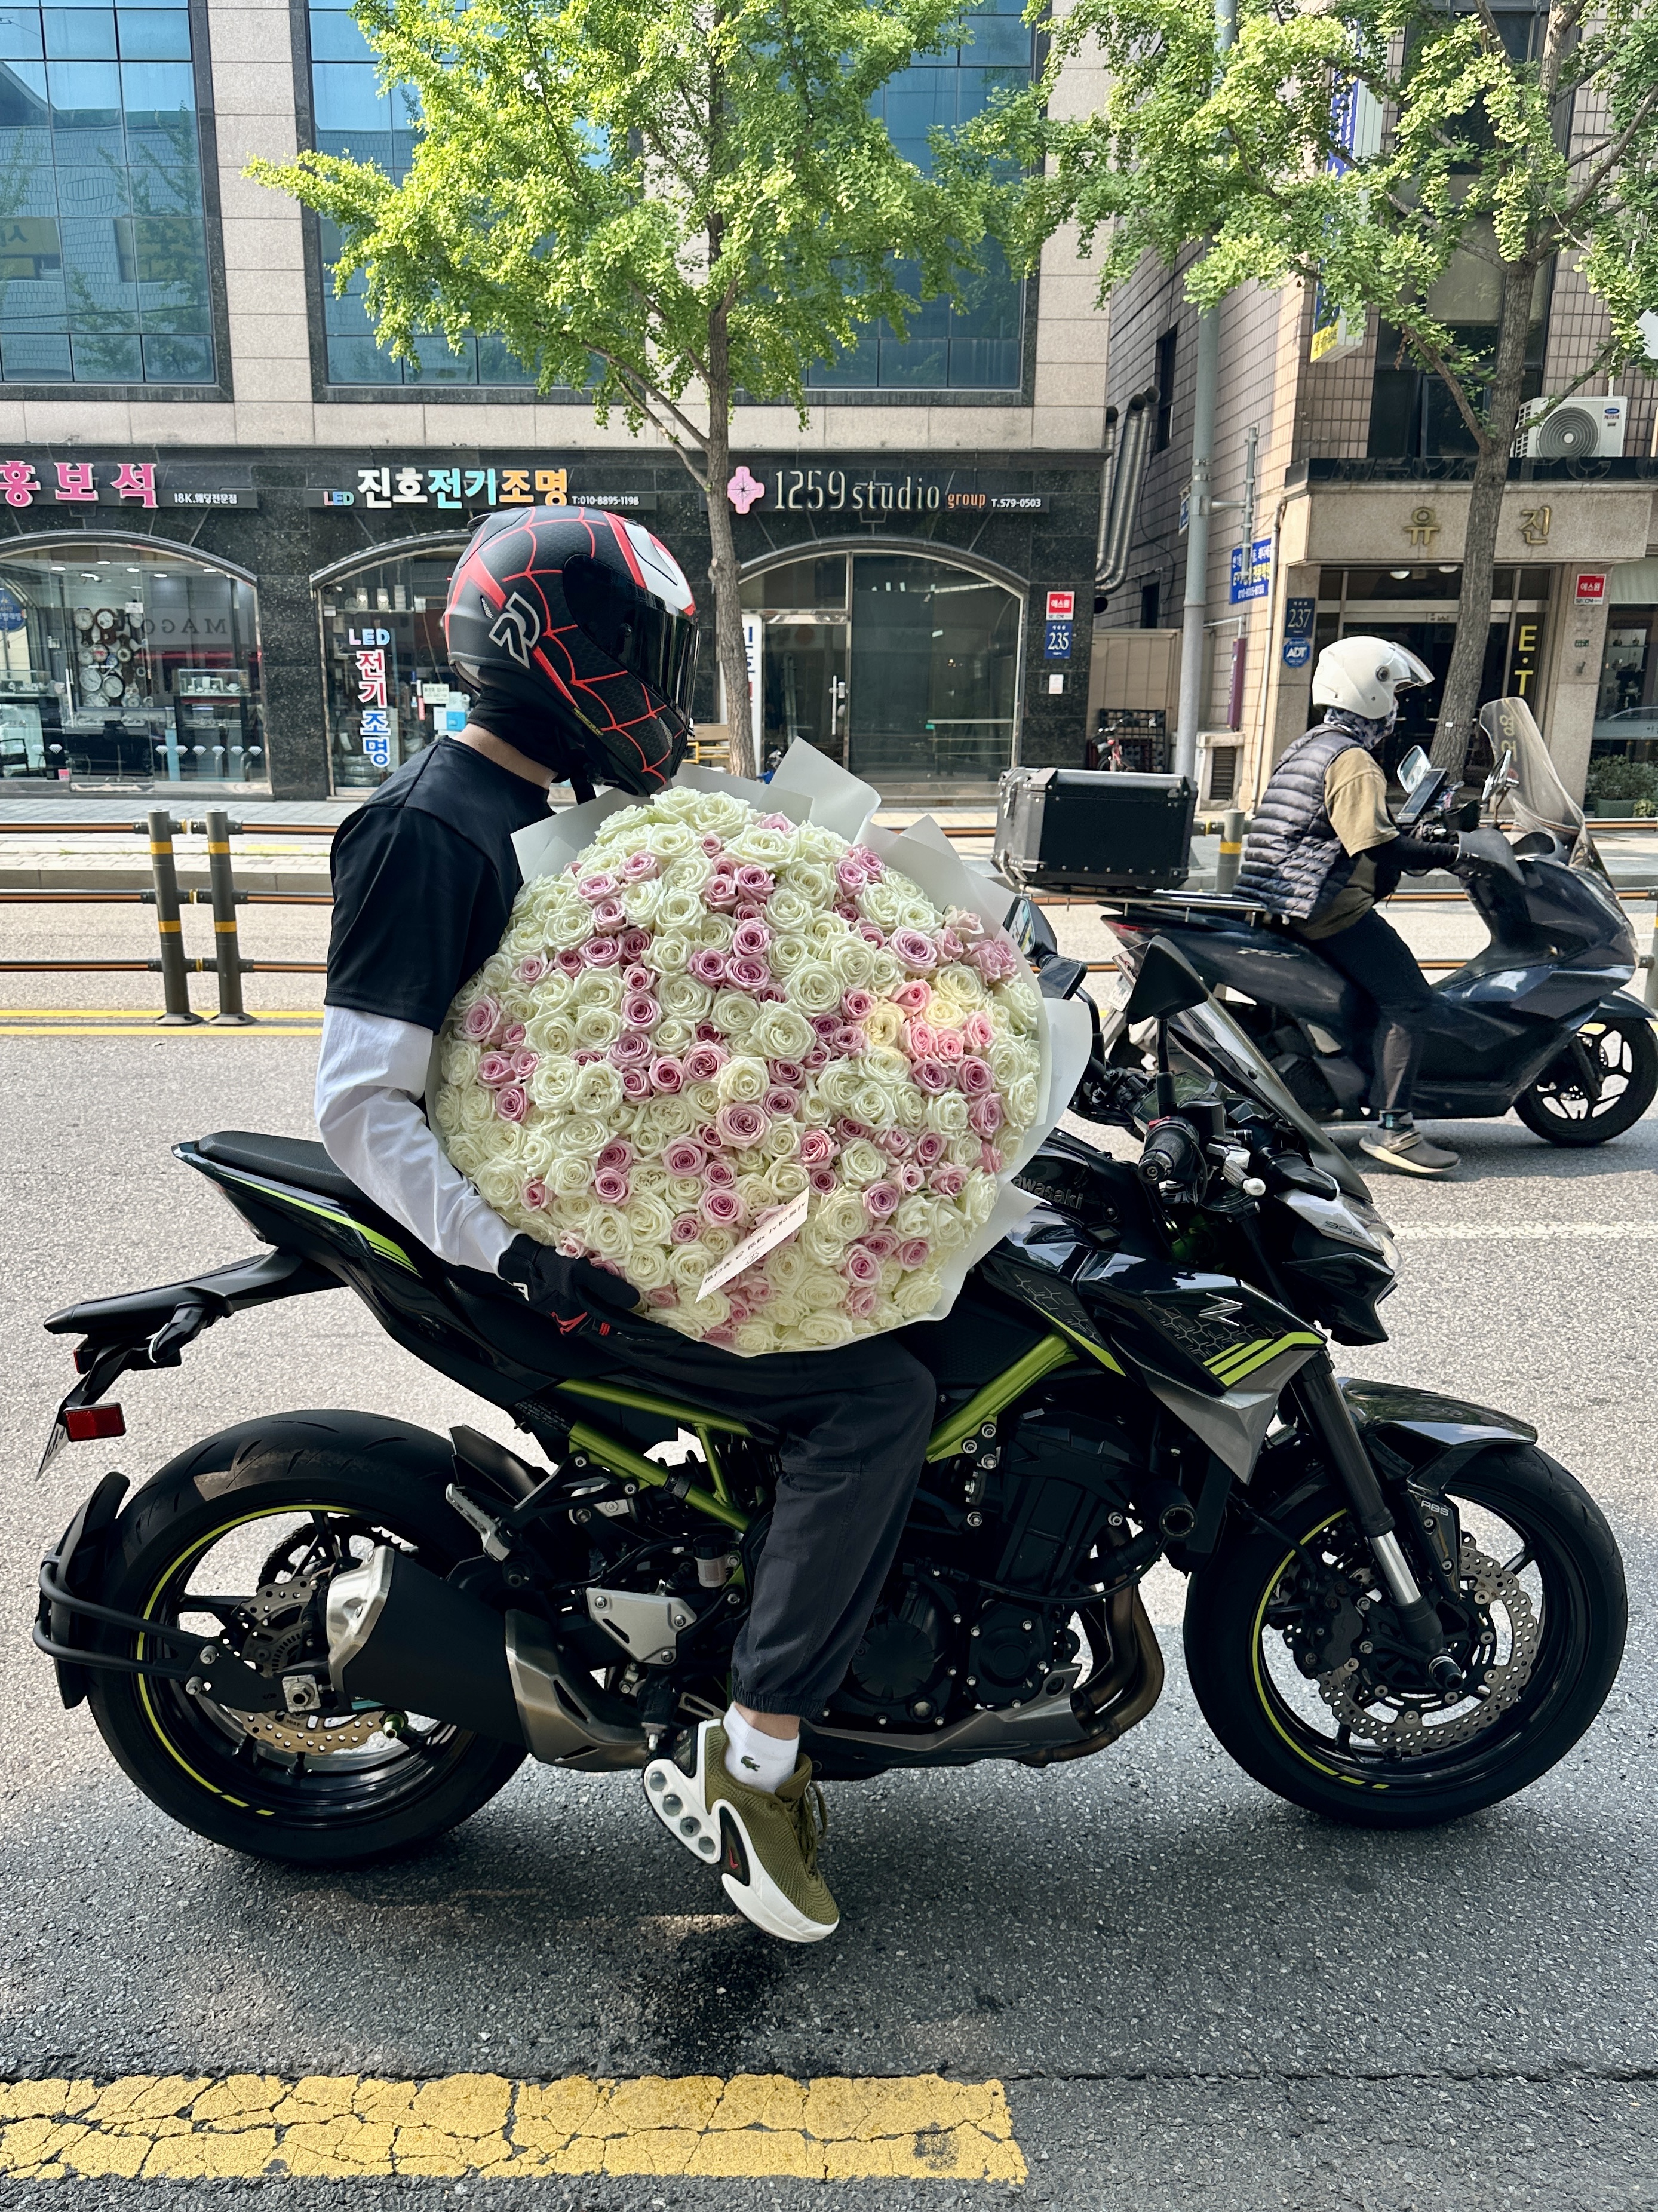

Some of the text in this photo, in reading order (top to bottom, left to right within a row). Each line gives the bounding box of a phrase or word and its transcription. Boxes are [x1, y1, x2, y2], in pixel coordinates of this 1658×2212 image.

[323, 490, 355, 506] LED
[357, 467, 568, 509] 진호전기조명
[774, 470, 1042, 510] 1259 studio group T.579-0503
[1288, 608, 1312, 628] 237
[348, 628, 391, 645] LED
[1048, 631, 1070, 651] 235
[1286, 646, 1308, 658] ADT
[355, 649, 391, 768] 전기조명
[1014, 1174, 1084, 1210] awasaki
[1421, 1499, 1449, 1517] ABS
